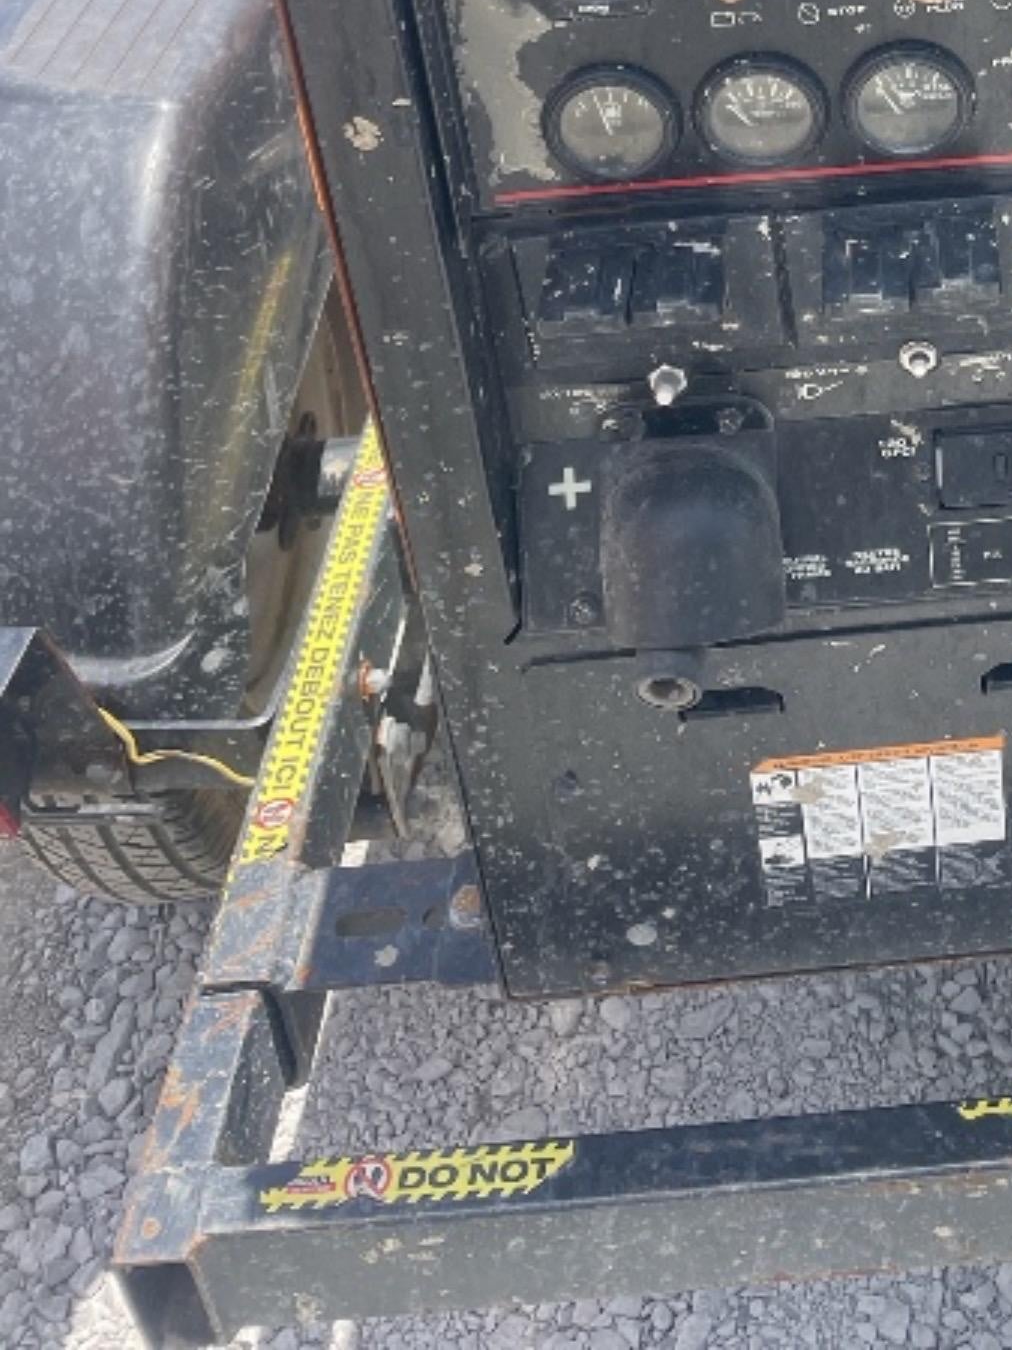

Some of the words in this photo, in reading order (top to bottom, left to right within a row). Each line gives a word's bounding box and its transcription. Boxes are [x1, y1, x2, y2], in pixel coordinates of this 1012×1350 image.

[339, 523, 365, 565] PAS
[317, 571, 351, 641] TENEZ
[286, 646, 330, 751] DEBOUT
[272, 756, 298, 791] ICI
[399, 1165, 460, 1190] DO
[467, 1157, 555, 1186] NOT
